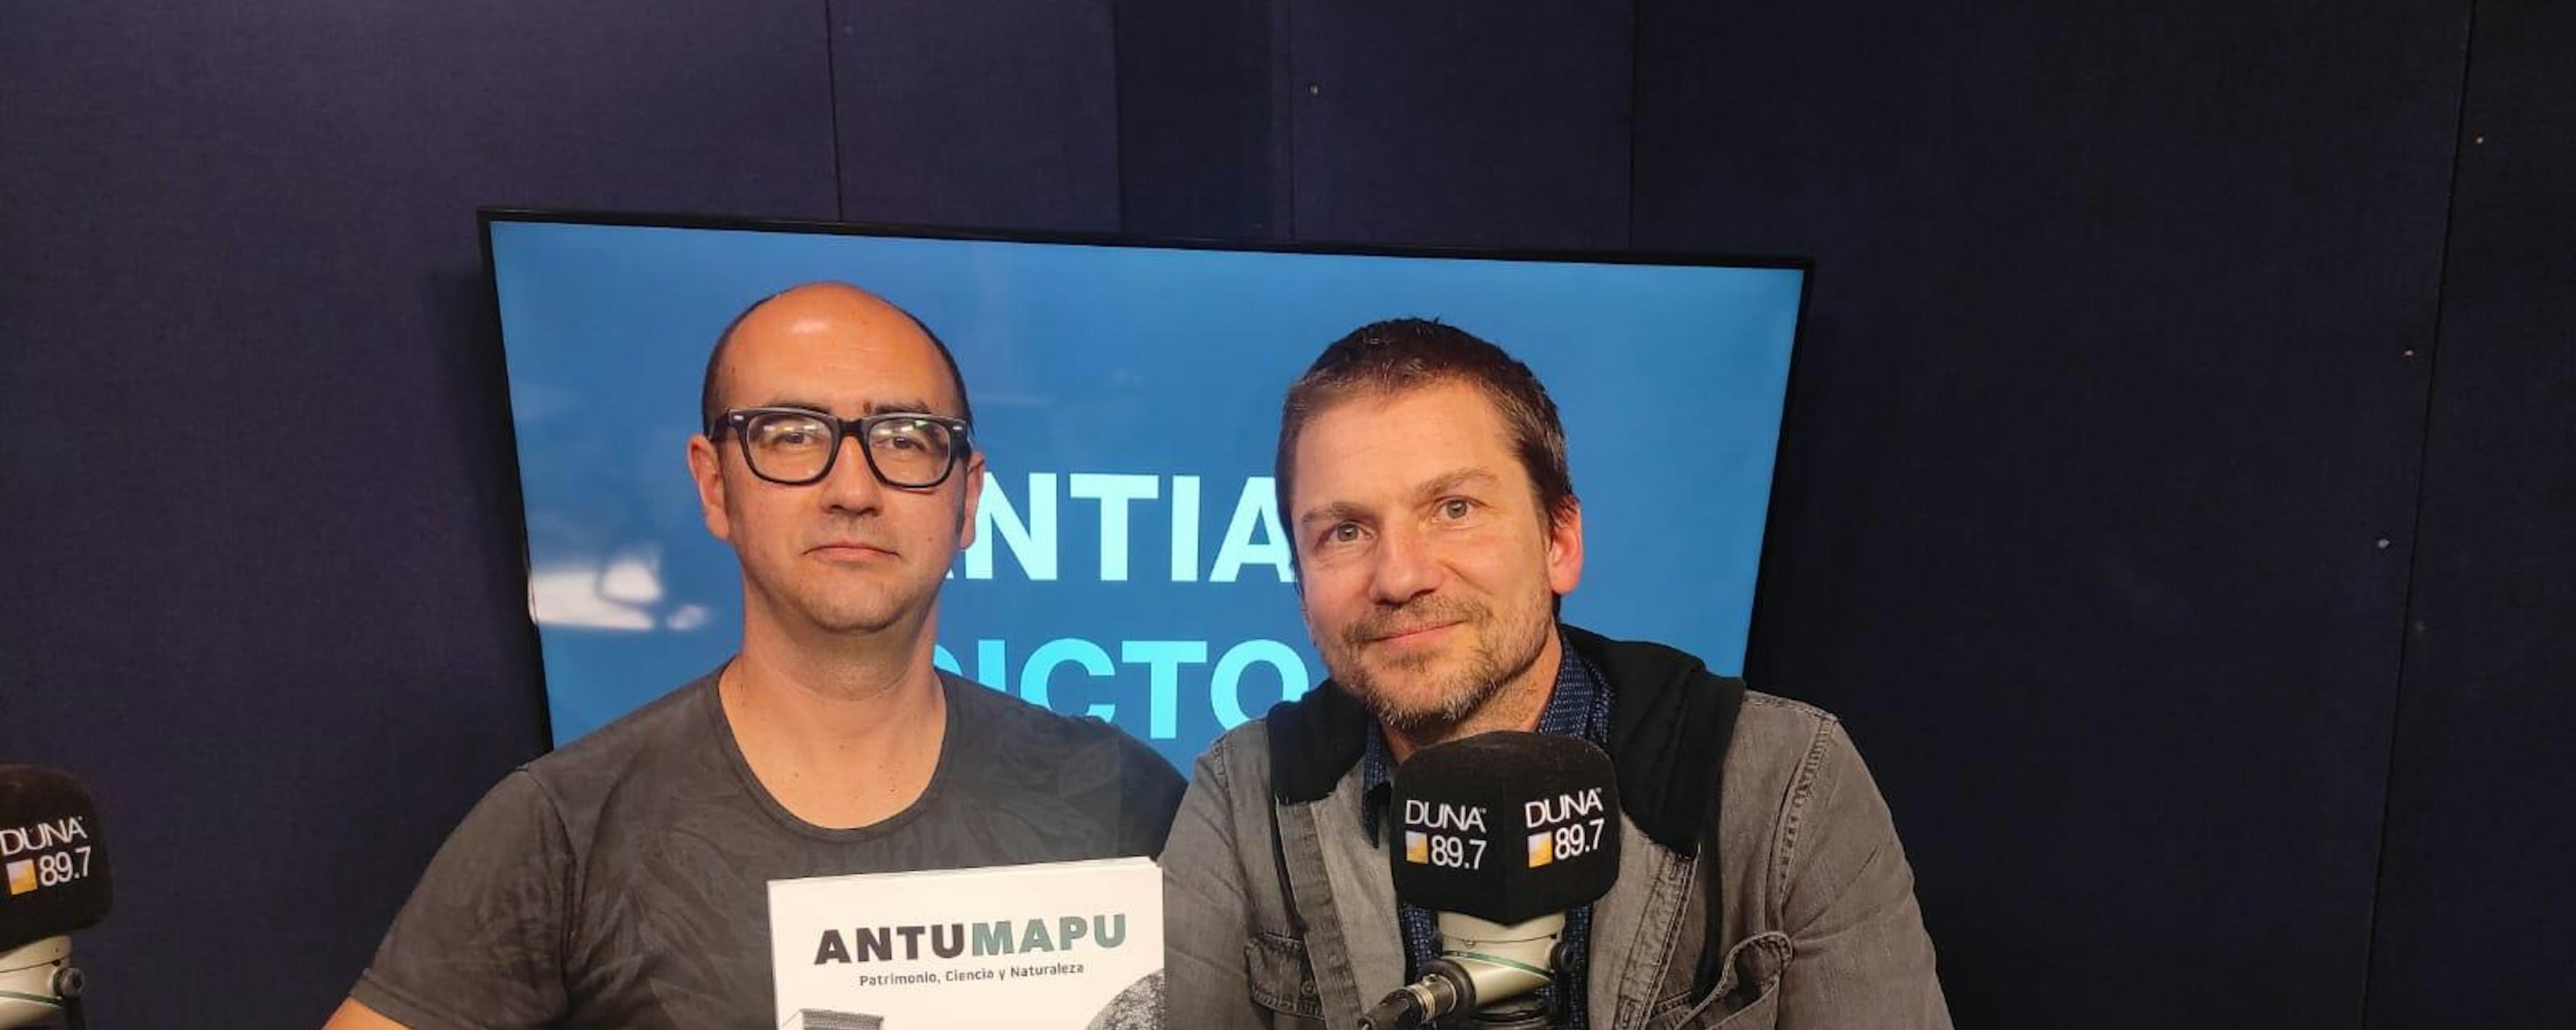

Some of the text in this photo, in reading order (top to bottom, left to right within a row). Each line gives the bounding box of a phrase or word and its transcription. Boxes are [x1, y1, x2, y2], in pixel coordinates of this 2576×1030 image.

[943, 472, 1297, 583] NTIA
[933, 638, 1311, 740] ICTO
[1405, 799, 1485, 833] DUNA
[1525, 787, 1603, 829] DUNA
[0, 815, 88, 856] DUNA
[1431, 834, 1487, 870] 89.7
[1554, 818, 1604, 860] 89.7
[39, 846, 92, 887] 89.7
[814, 913, 1126, 966] ANTUMAPU
[859, 962, 1084, 987] Patrimonio, Ciencia y Naturaleza
